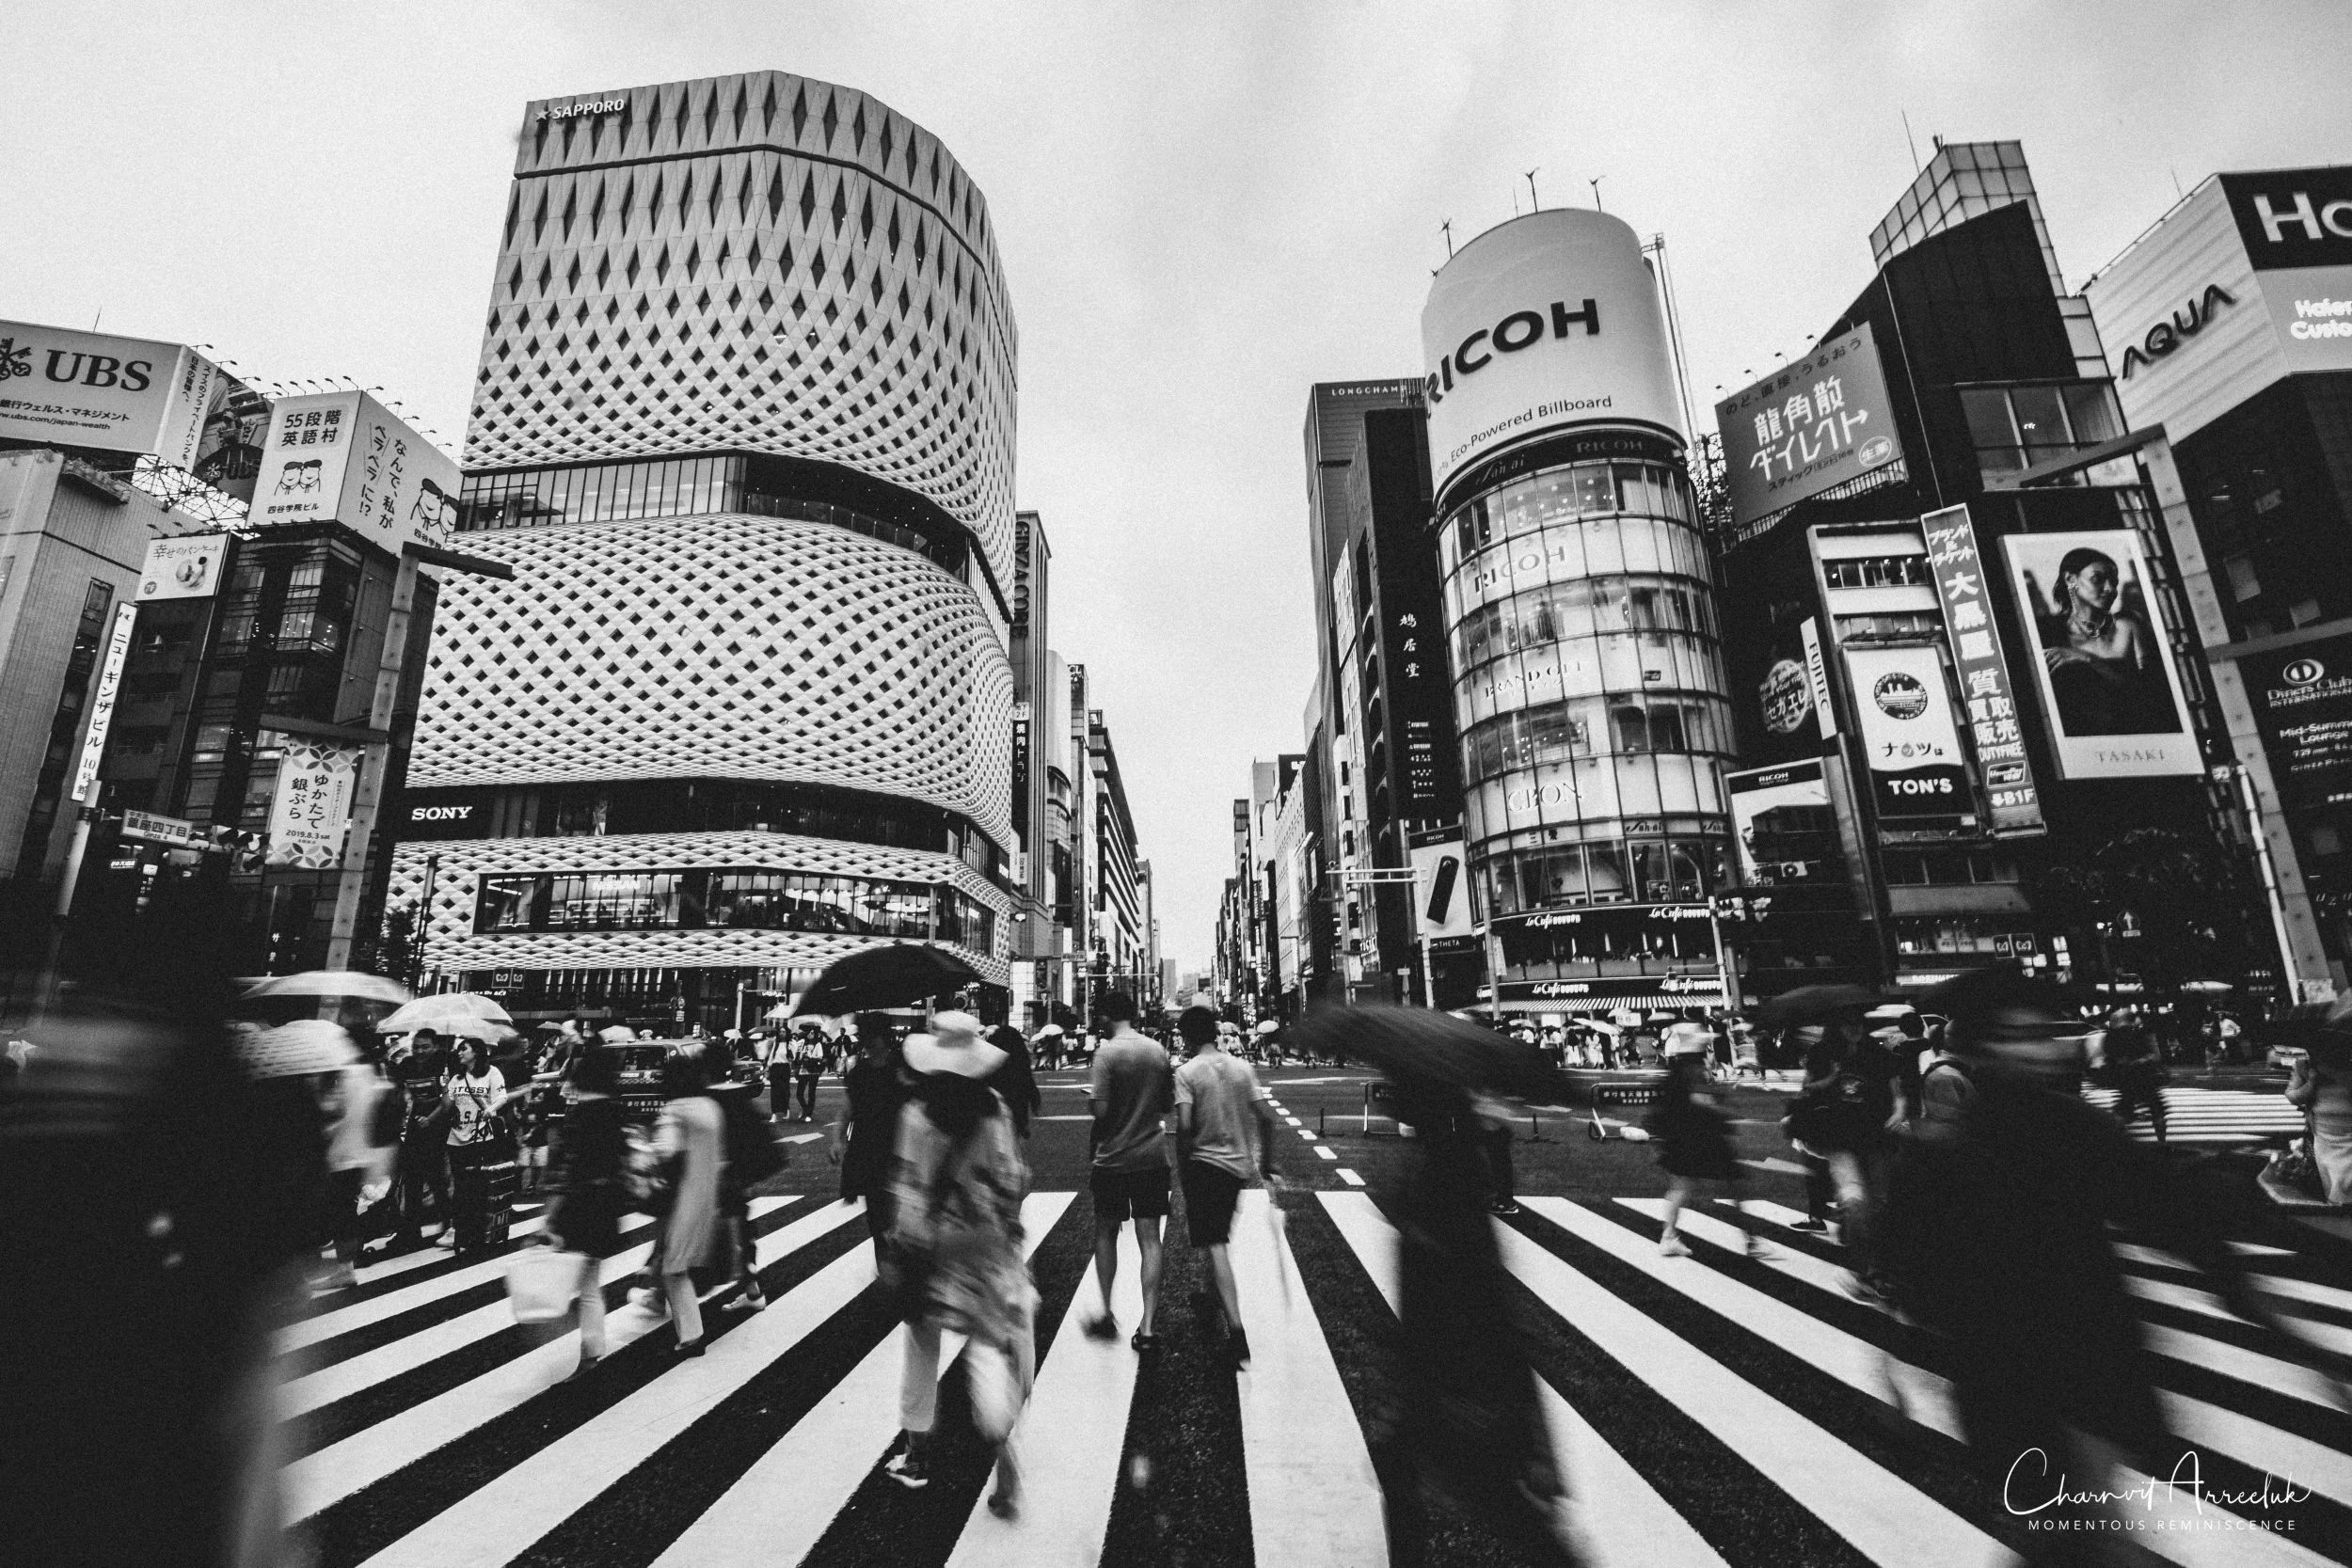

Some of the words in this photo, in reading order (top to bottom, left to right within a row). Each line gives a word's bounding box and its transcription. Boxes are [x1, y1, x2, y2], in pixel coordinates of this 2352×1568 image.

[551, 98, 625, 119] SAPPORO
[2122, 284, 2237, 380] AQUA
[44, 348, 152, 392] UBS
[1426, 298, 1599, 420] RICOH
[0, 412, 111, 430] w.ubs.com/japan-wealth
[284, 408, 342, 429] 55段階
[1450, 408, 1534, 464] Eco-Powered
[1538, 395, 1613, 419] Billboard
[1753, 374, 1846, 447] 龍角散
[281, 428, 338, 447] 英語村
[1576, 439, 1644, 453] RICOH
[1749, 409, 1868, 482] ダイレクト
[1473, 546, 1566, 594] RICOH
[1807, 641, 1830, 712] FUJITEC
[1967, 667, 2002, 699] 質
[2096, 749, 2166, 763] TASAKI
[288, 777, 309, 820] 銀ぶら
[307, 774, 329, 830] ゆかたで
[1887, 777, 1953, 796] TON'S
[411, 805, 473, 821] SONY
